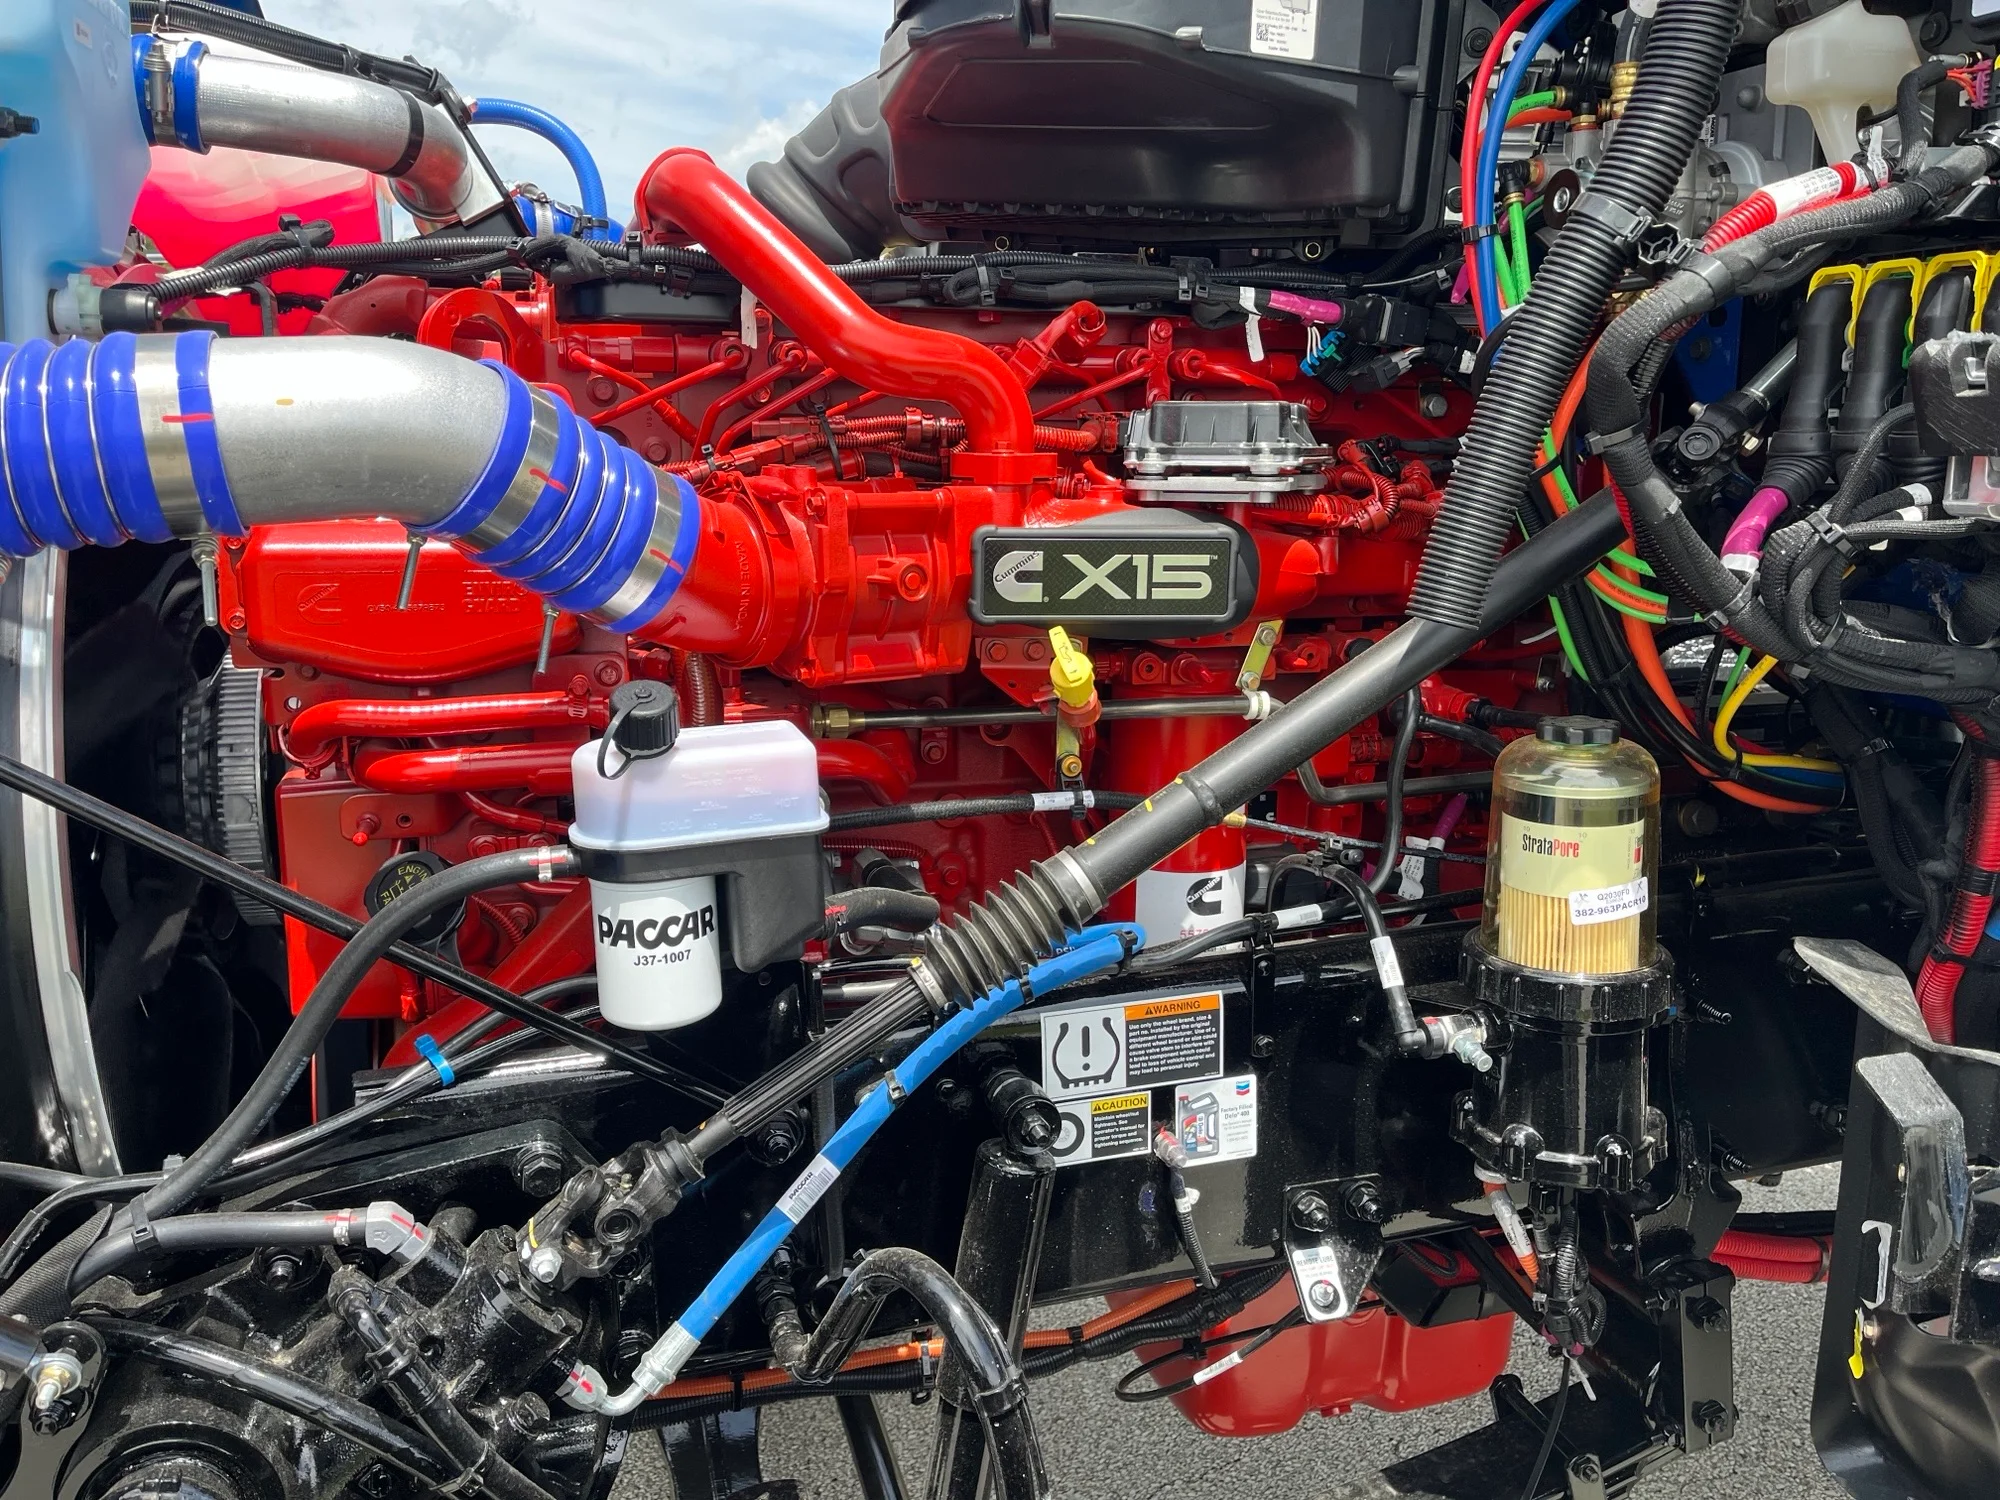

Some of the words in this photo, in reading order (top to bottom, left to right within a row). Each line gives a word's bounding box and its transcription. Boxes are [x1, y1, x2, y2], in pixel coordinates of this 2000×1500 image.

[735, 540, 750, 580] MADE
[994, 550, 1040, 584] Cummins
[1060, 554, 1212, 600] X15
[741, 584, 751, 596] IN
[1522, 833, 1580, 858] StrataPore
[398, 865, 428, 880] ENGIN
[1186, 877, 1220, 903] Cummins
[598, 904, 714, 950] PACCAR
[634, 949, 692, 966] J37-1007
[1154, 1000, 1200, 1014] WARNING
[1150, 1052, 1179, 1060] component
[1102, 1096, 1146, 1110] CAUTION
[1094, 1141, 1118, 1149] tightening
[788, 1172, 814, 1200] PACCAR
